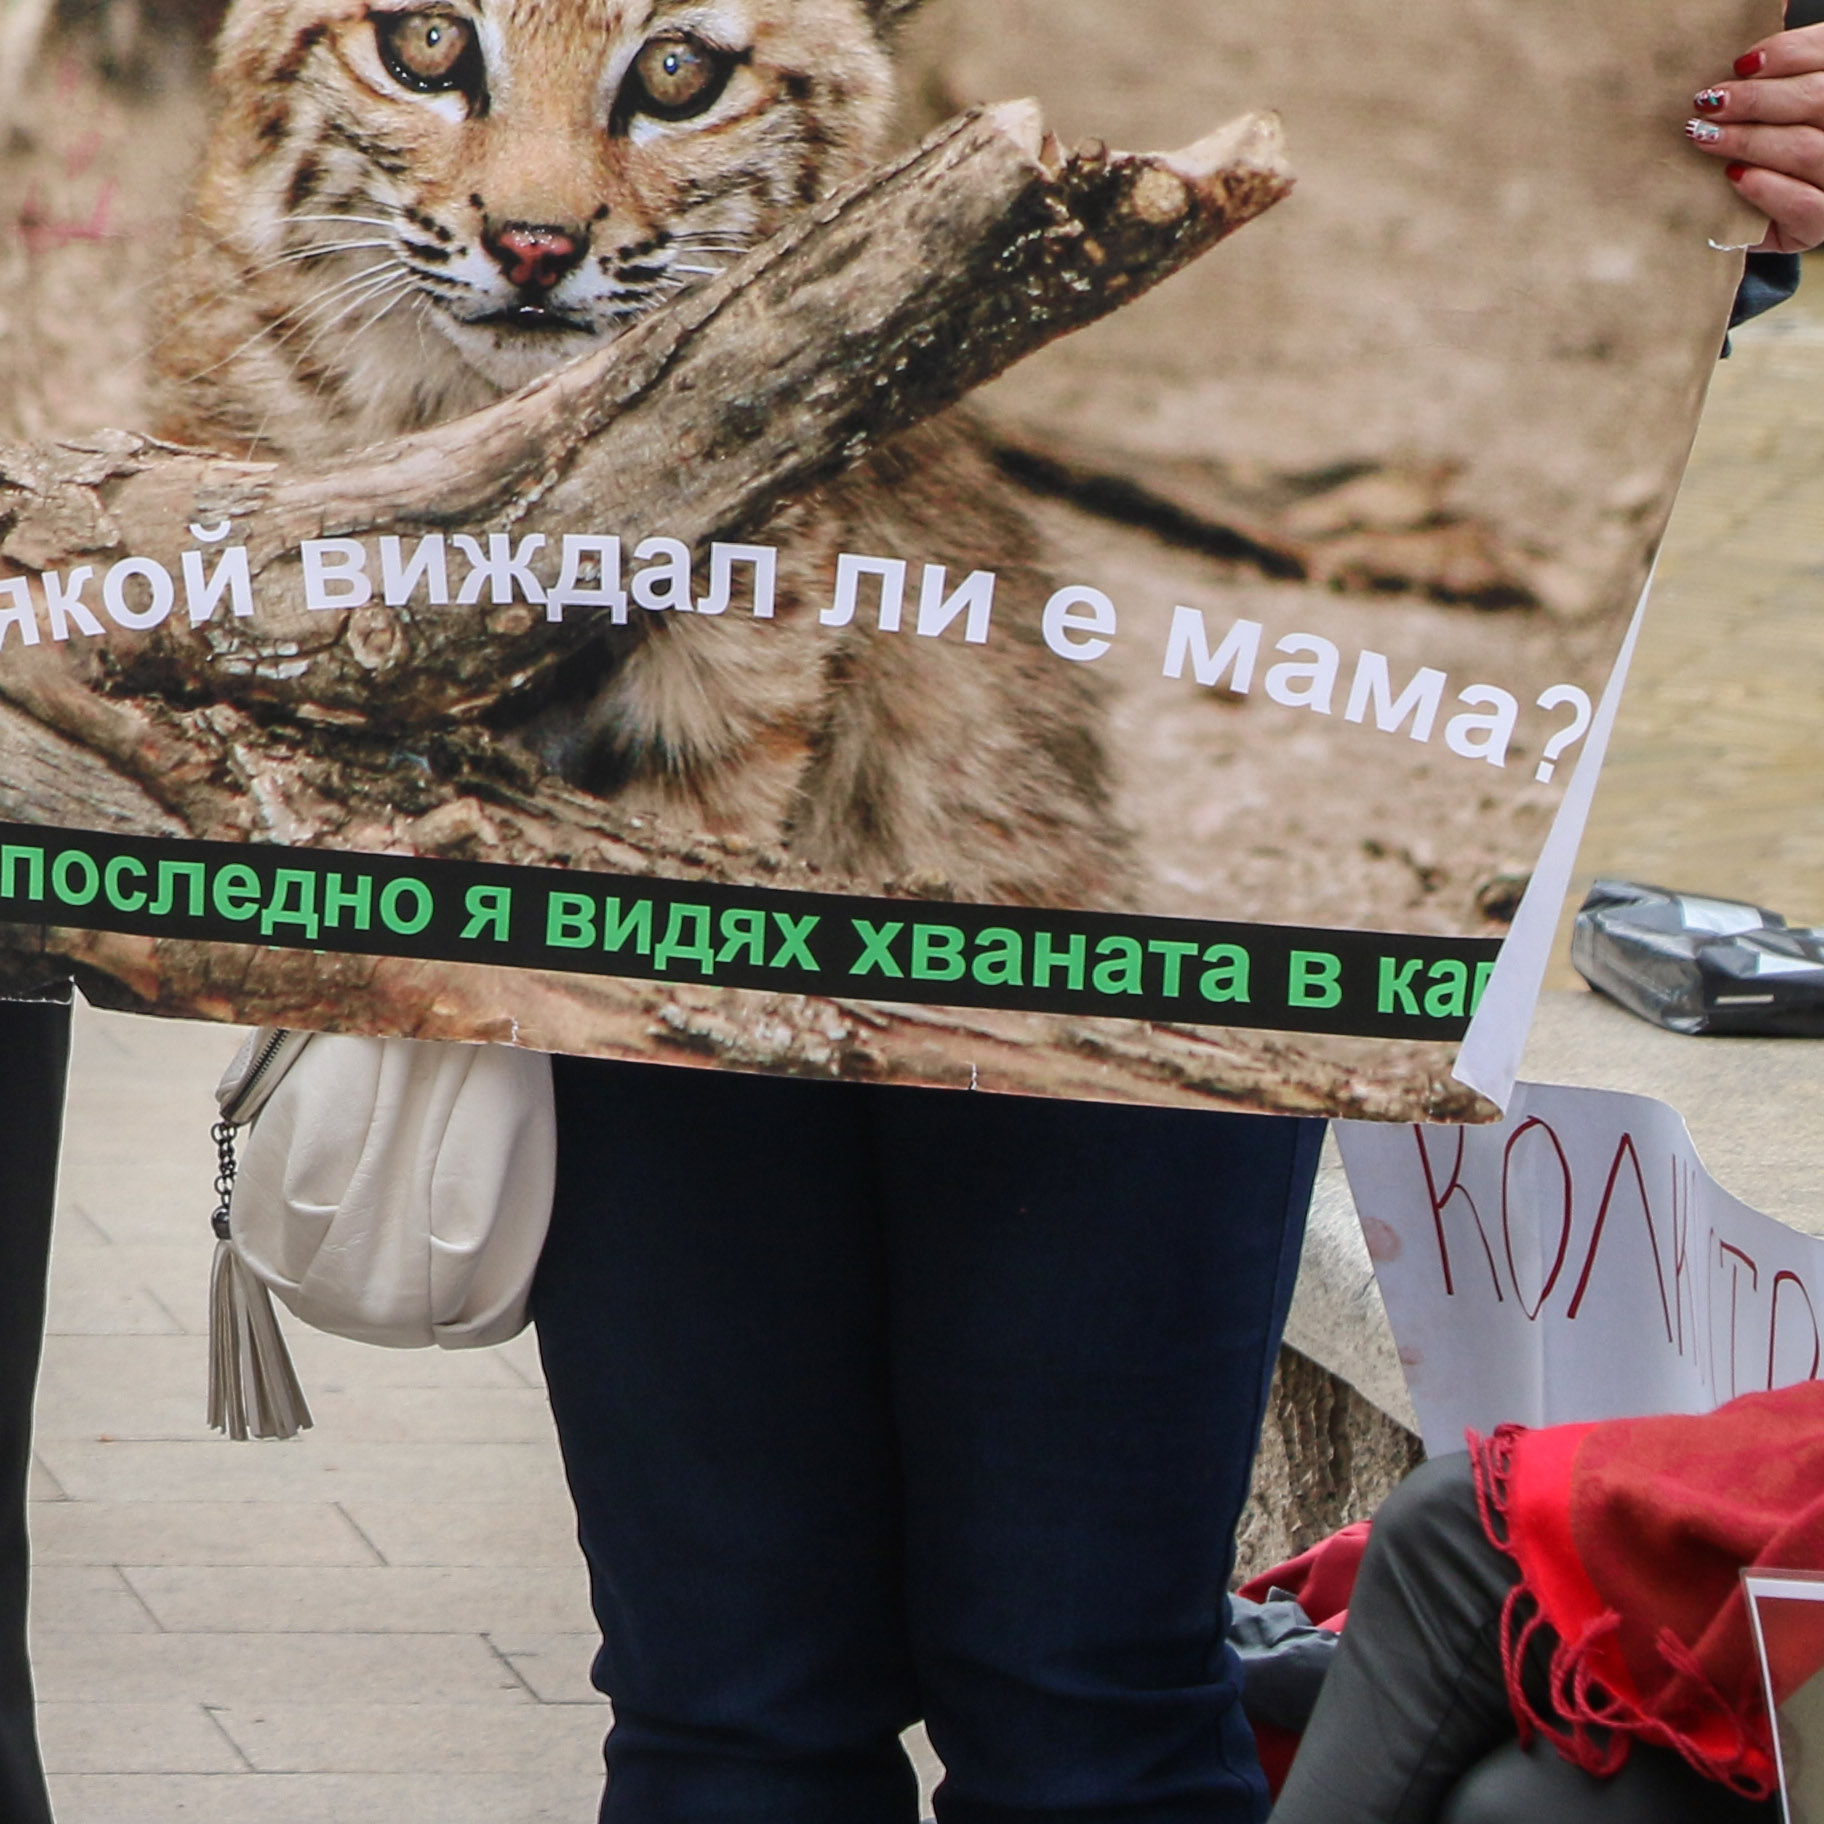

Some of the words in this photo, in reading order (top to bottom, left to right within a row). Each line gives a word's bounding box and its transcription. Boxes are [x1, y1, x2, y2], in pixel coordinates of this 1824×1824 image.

[299, 532, 778, 625] виждал
[818, 552, 996, 644] ли
[1041, 584, 1118, 662] е
[1161, 605, 1593, 784] мама?
[458, 882, 516, 944] я
[542, 888, 824, 976] видях
[846, 915, 1254, 1006] хваната
[1283, 947, 1346, 1012] в
